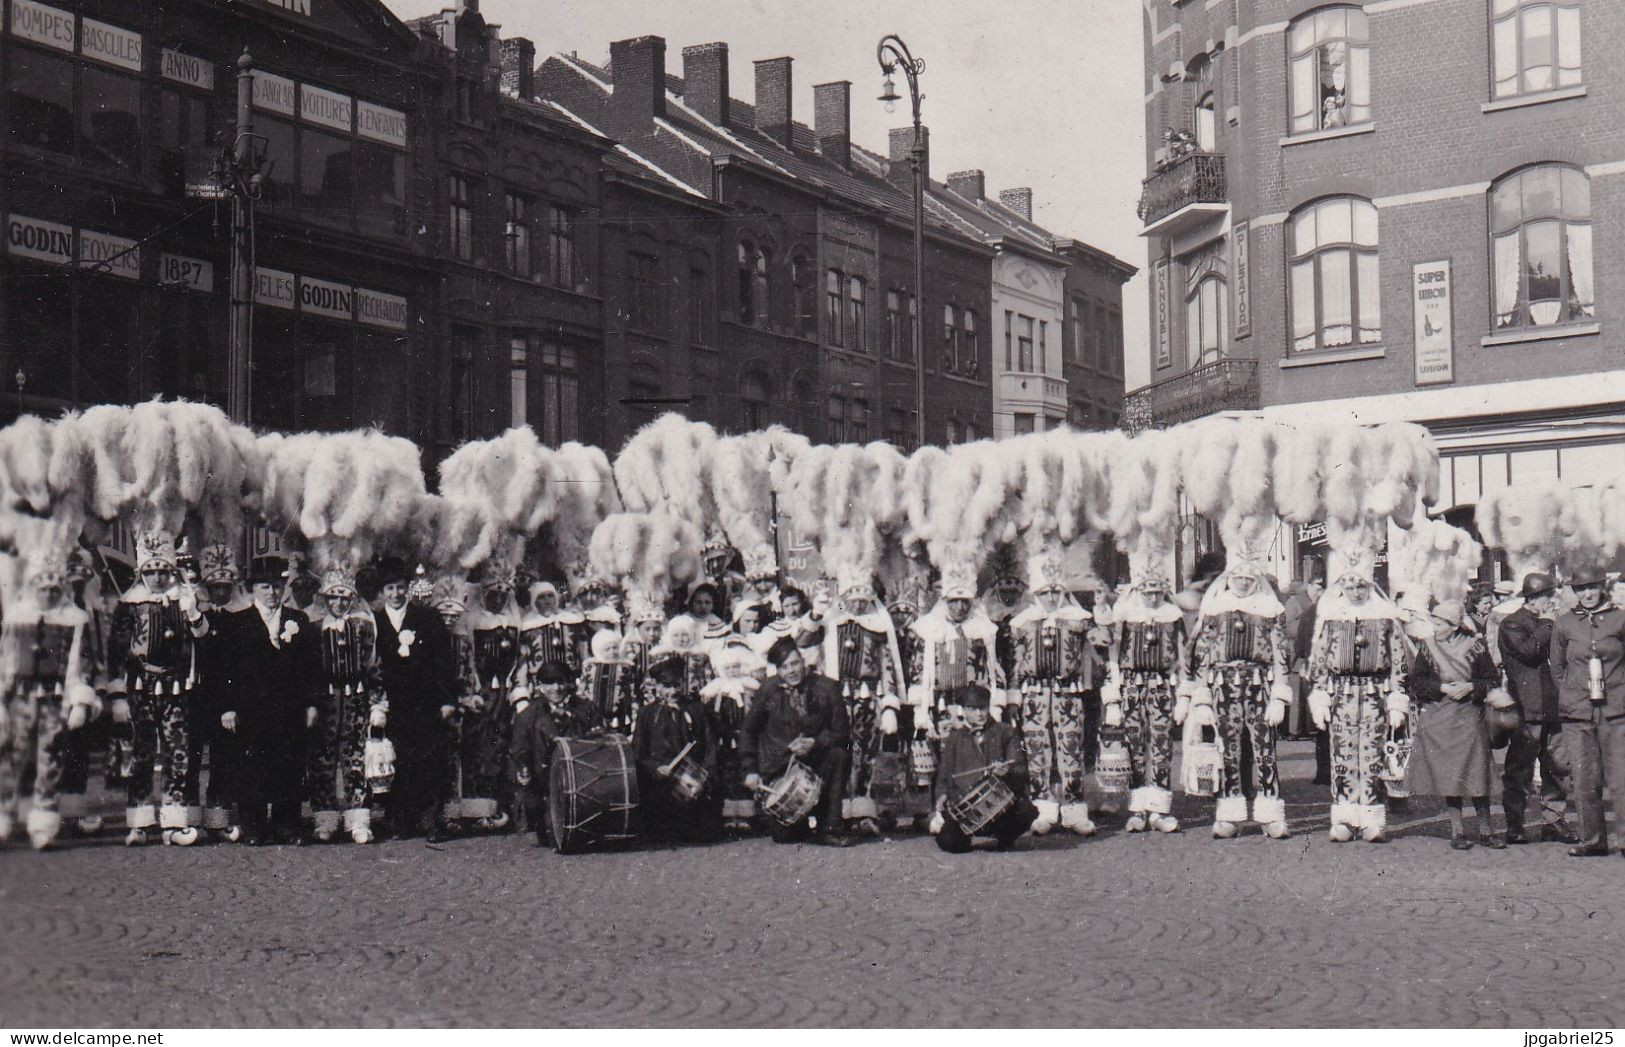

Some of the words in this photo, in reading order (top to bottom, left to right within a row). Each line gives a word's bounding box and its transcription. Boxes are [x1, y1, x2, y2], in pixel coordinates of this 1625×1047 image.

[12, 3, 73, 42] POMPES
[82, 25, 141, 63] BASCULES
[165, 53, 199, 82] ANNO
[301, 89, 351, 124] VOITURES
[8, 221, 72, 257] GODIN
[80, 236, 139, 271] FOYERS
[164, 255, 202, 286] 1827
[1418, 271, 1446, 284] SUPER
[301, 283, 351, 313] GODIN
[1419, 363, 1449, 375] UNION
[788, 557, 807, 570] DU
